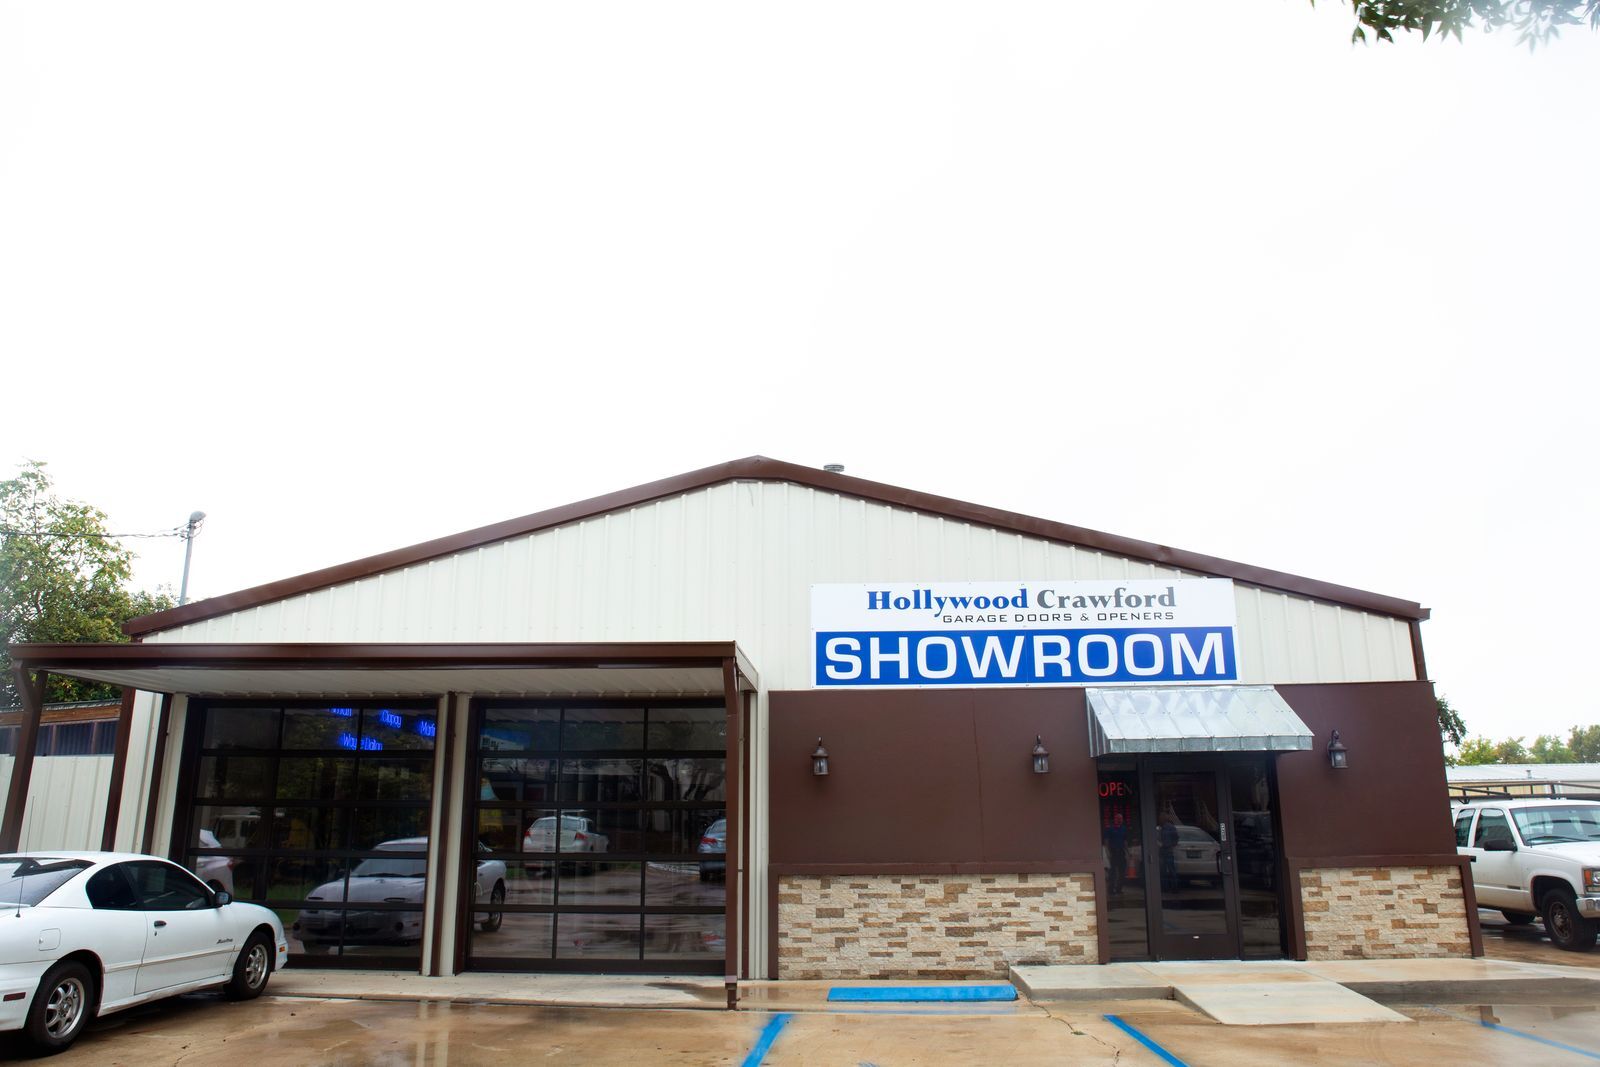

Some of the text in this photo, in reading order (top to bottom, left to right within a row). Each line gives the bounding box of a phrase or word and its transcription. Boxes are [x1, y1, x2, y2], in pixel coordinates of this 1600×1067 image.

[867, 586, 1177, 617] Hollywood Crawford
[942, 612, 1175, 624] GARAGE DOORS & OPENERS
[825, 632, 1226, 680] SHOWROOM
[1098, 781, 1132, 798] OPEN
